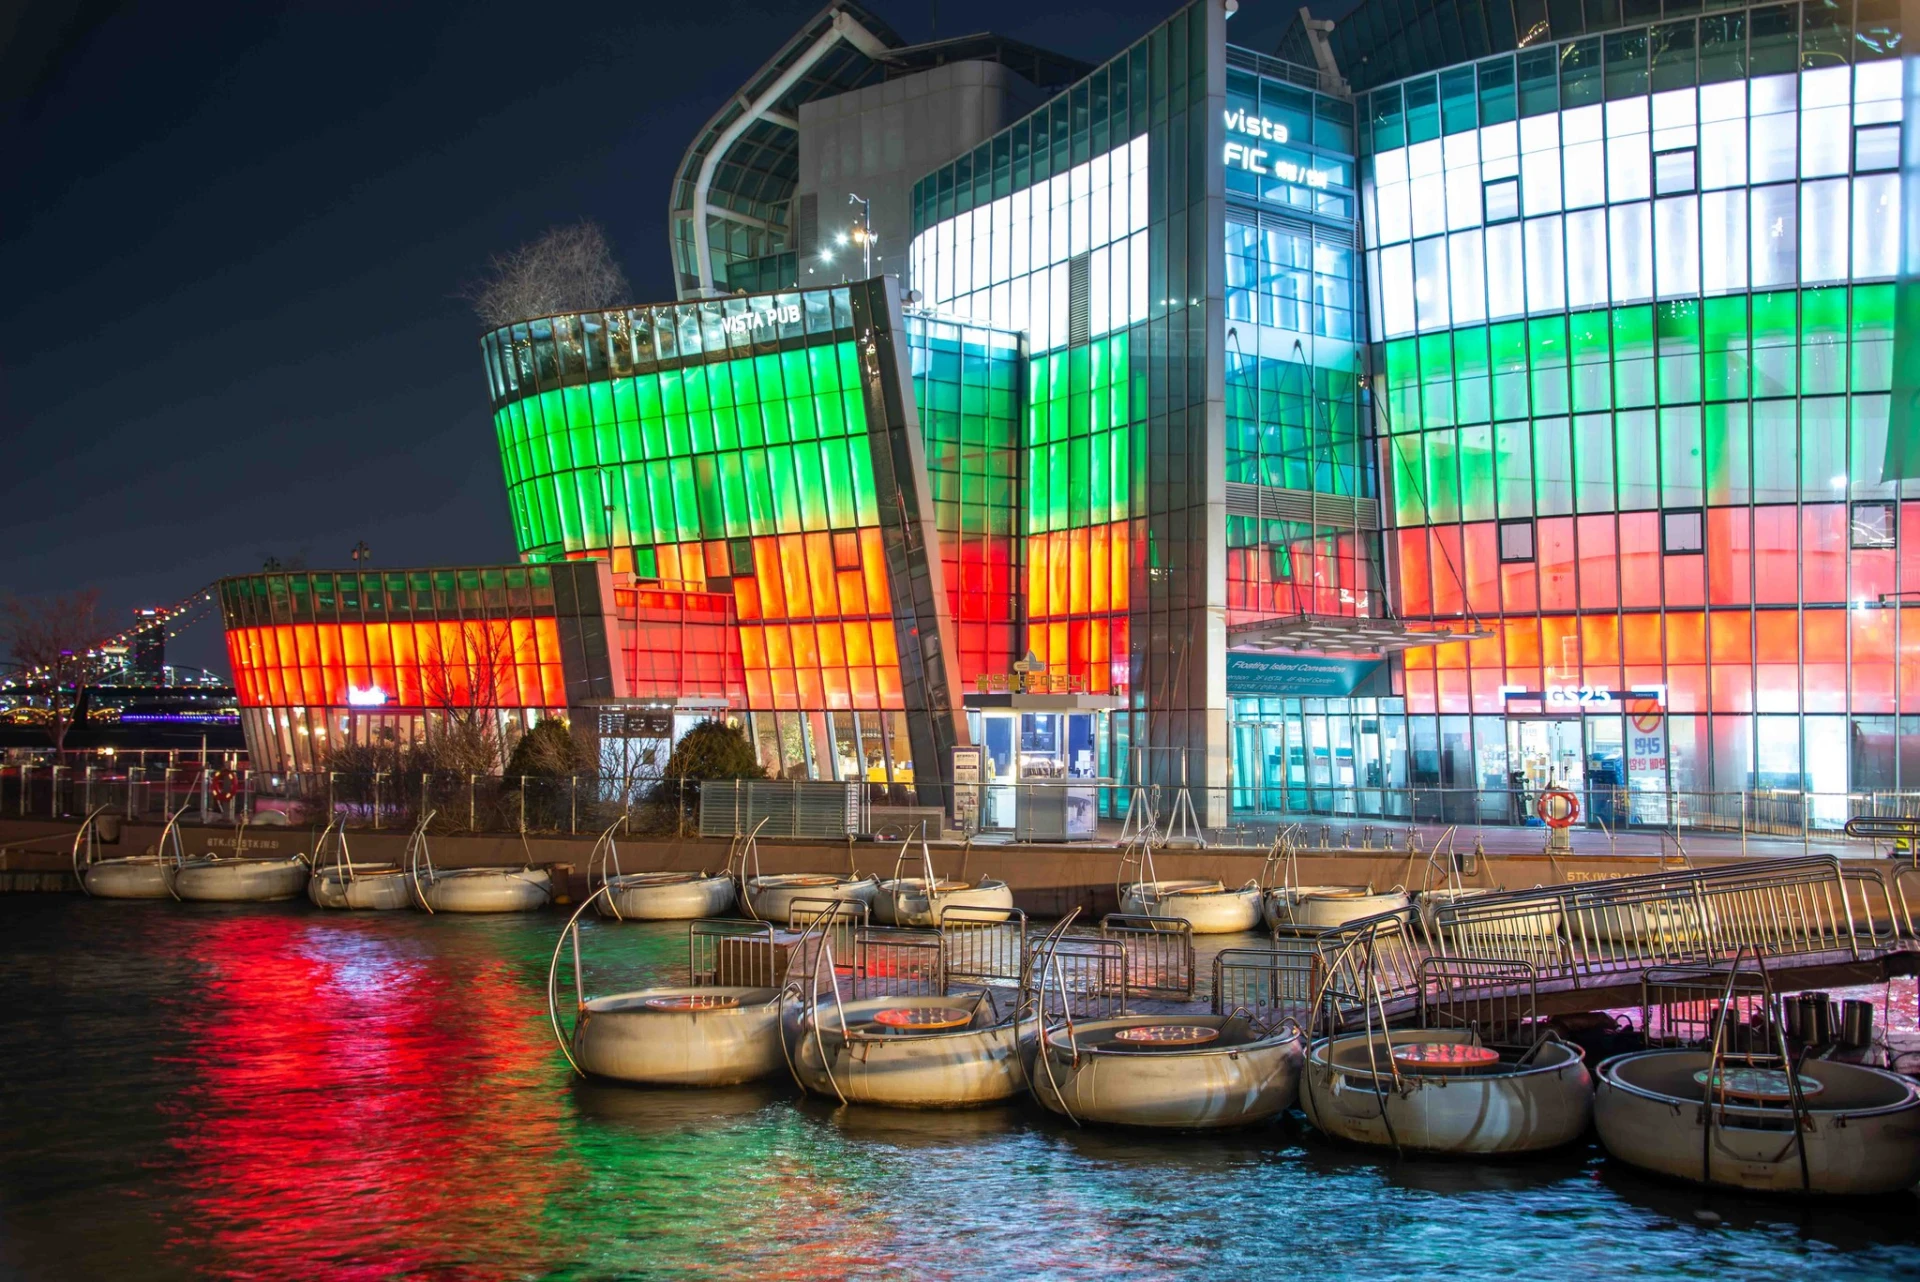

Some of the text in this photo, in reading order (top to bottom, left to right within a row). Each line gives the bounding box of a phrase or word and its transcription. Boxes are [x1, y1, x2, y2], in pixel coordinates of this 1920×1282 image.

[1224, 108, 1288, 143] vista
[1224, 142, 1268, 174] FIC
[721, 304, 801, 334] VISTA PUB
[1232, 660, 1346, 673] Floating Island Convention
[1546, 684, 1611, 707] GS25
